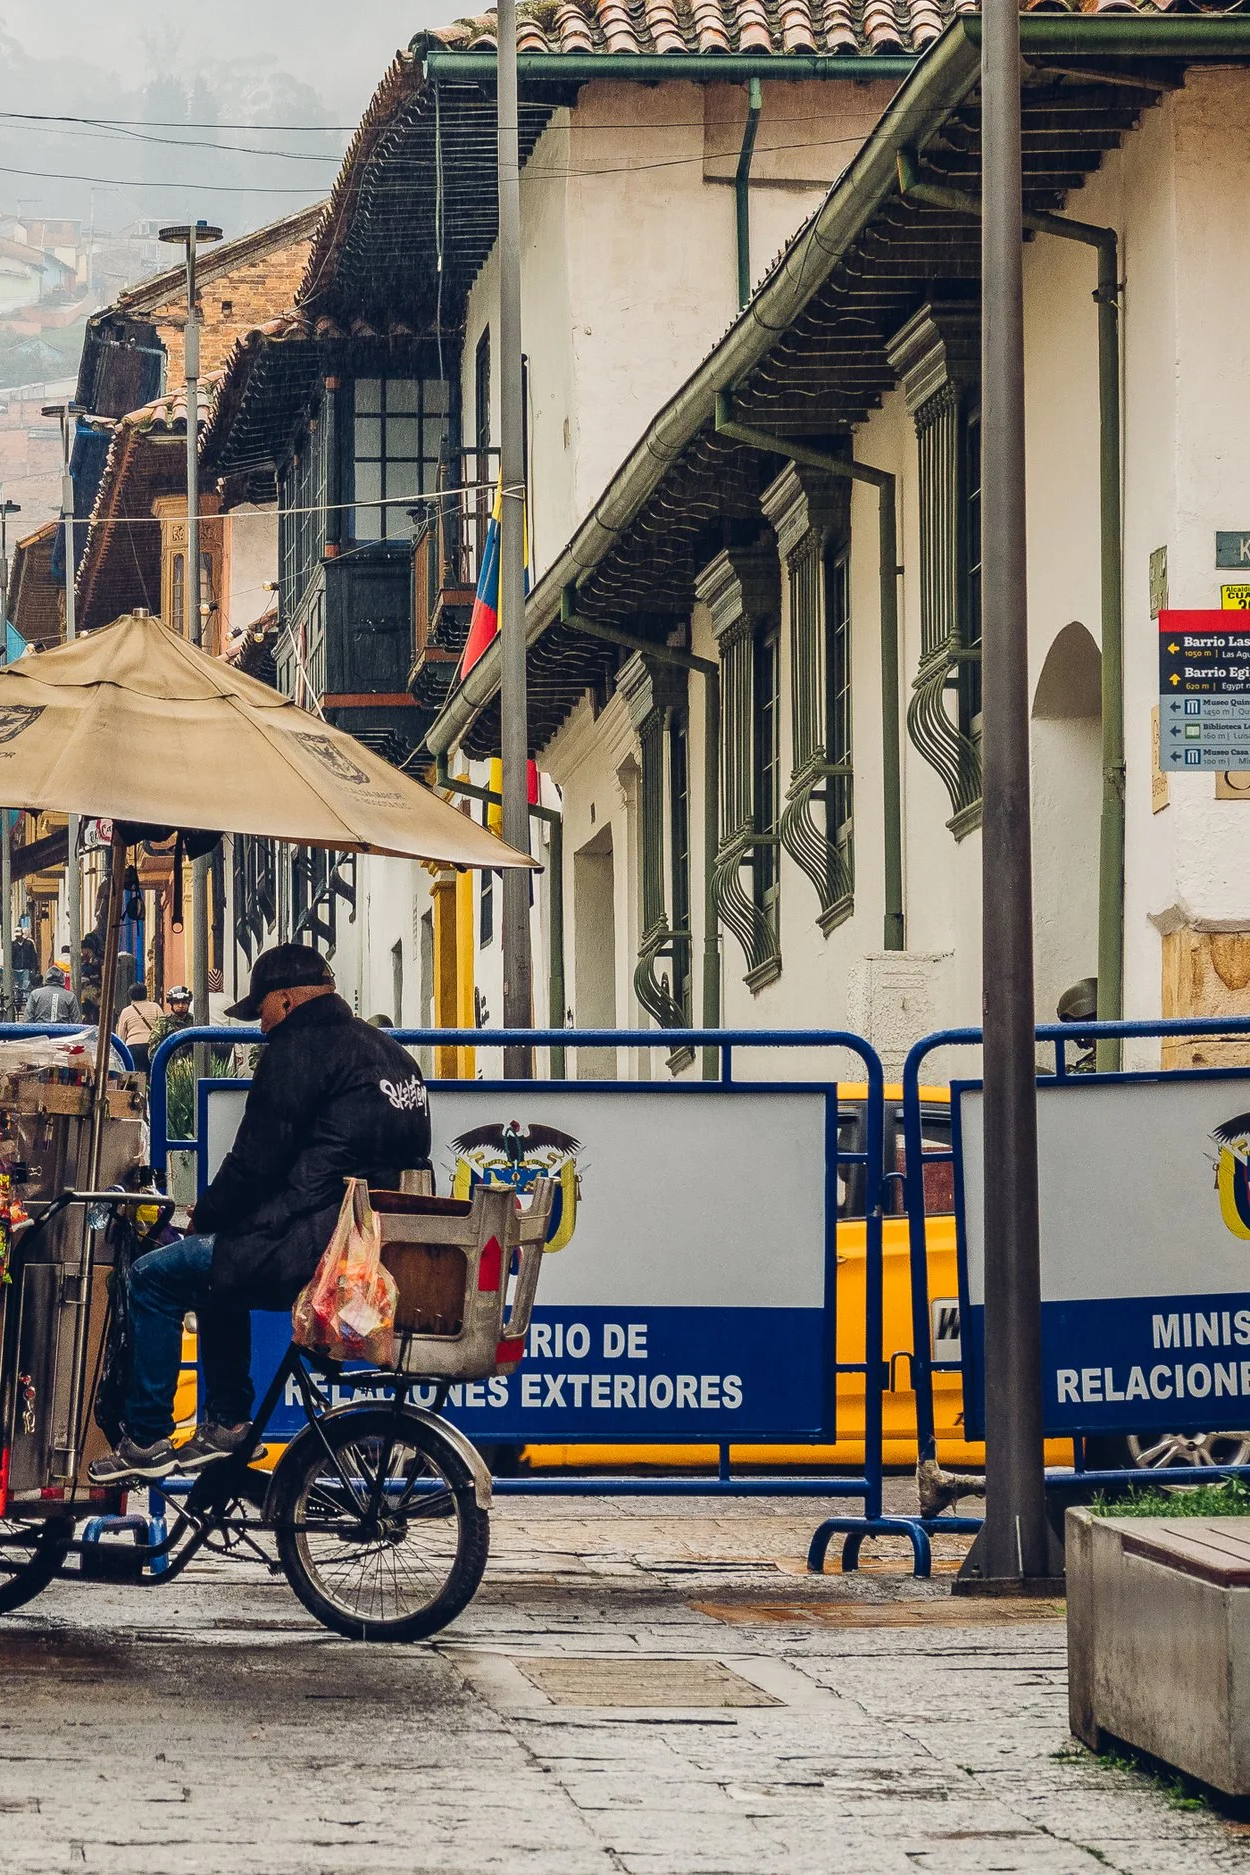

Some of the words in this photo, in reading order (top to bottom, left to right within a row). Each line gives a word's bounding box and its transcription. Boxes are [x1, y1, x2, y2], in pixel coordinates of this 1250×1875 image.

[1183, 636, 1226, 647] Barrio
[1228, 636, 1250, 647] Las
[1185, 650, 1202, 658] 1050
[1222, 650, 1235, 658] Las
[1184, 666, 1227, 678] Barrio
[1229, 666, 1250, 680] Egi
[1186, 682, 1200, 690] 620
[1222, 682, 1244, 691] Egypt
[1152, 1310, 1250, 1349] MINIS
[522, 1323, 591, 1358] RIO
[603, 1323, 648, 1358] DE
[521, 1374, 743, 1409] EXTERIORES
